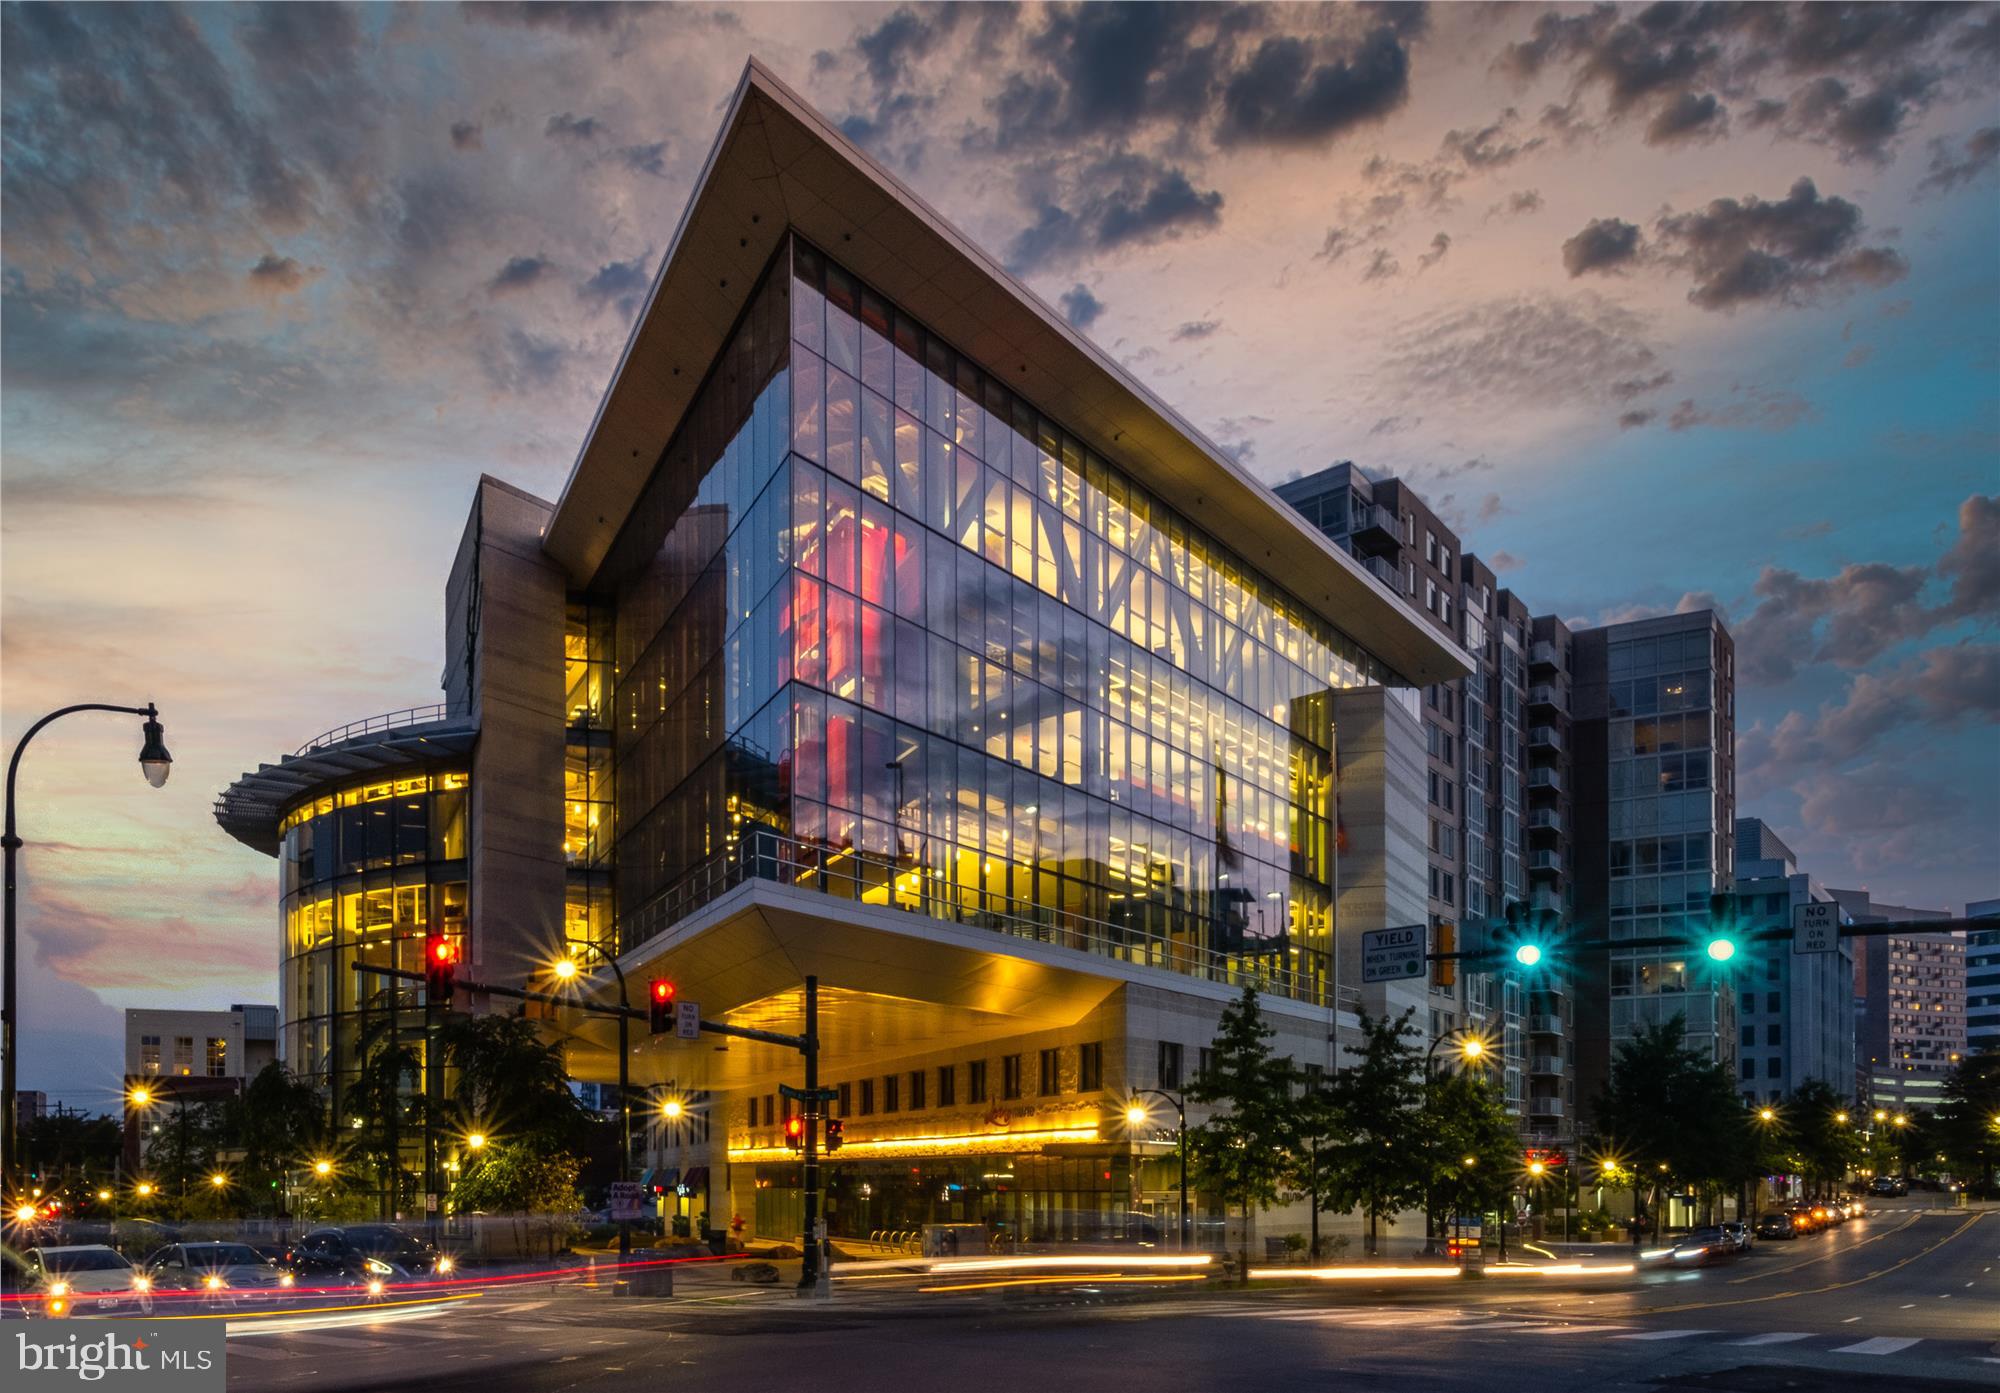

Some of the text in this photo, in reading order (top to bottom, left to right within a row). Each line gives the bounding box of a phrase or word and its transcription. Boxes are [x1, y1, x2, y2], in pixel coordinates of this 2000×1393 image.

[1806, 906, 1826, 917] NO
[1804, 919, 1829, 928] TURN
[1376, 931, 1413, 946] YIELD
[1809, 930, 1823, 938] ON
[1806, 941, 1826, 949] RED
[1366, 949, 1420, 963] WHEN TURNING
[1366, 965, 1401, 977] ON GREEN
[683, 1004, 694, 1012] NO
[613, 1184, 636, 1192] Adopt
